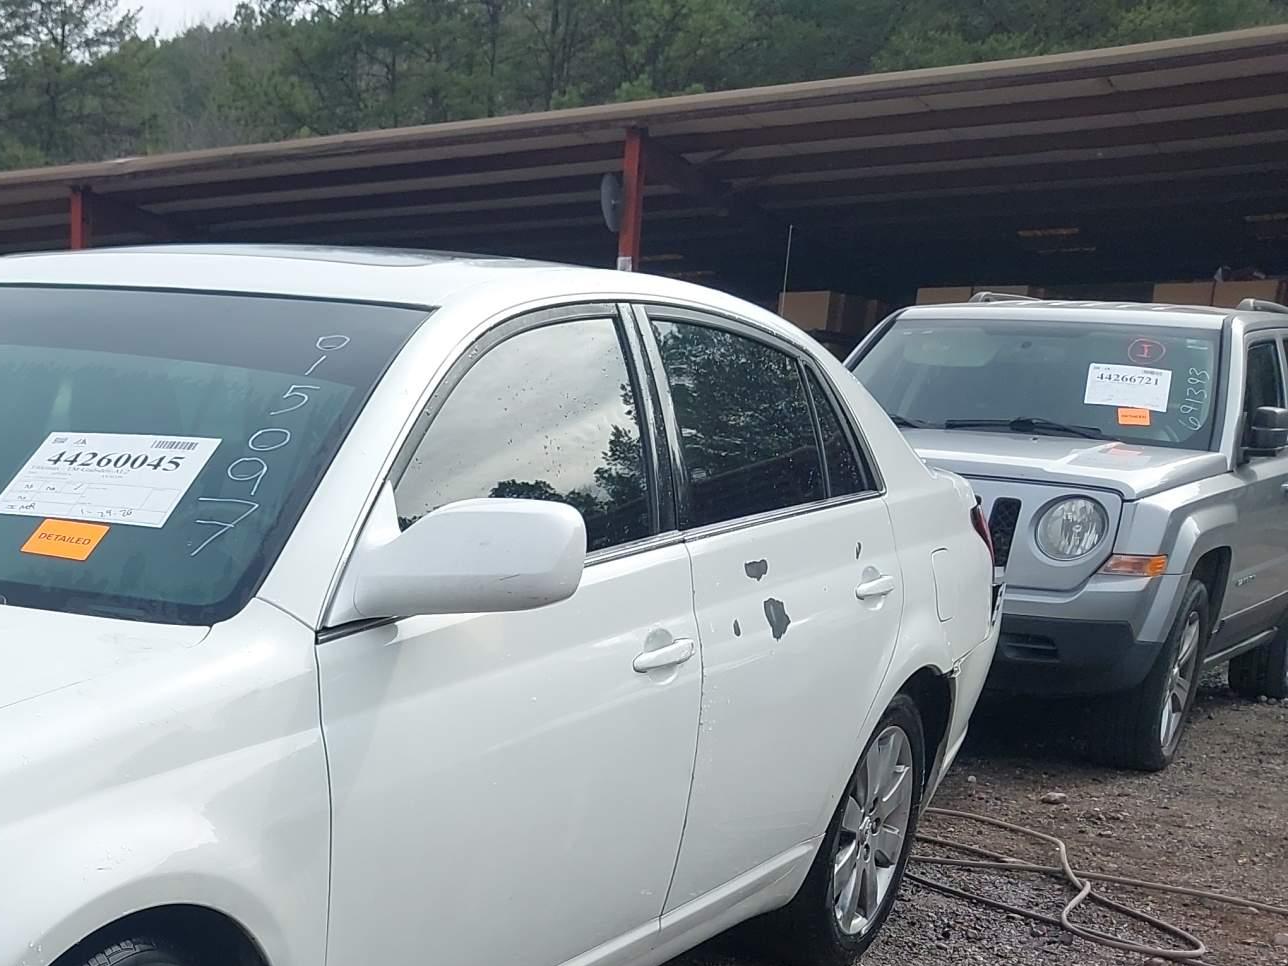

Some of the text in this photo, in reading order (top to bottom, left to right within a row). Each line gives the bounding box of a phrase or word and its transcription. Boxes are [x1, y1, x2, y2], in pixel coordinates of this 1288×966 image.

[1096, 373, 1159, 386] 44266721
[47, 450, 185, 472] 44260045
[38, 532, 92, 546] DETAILED
